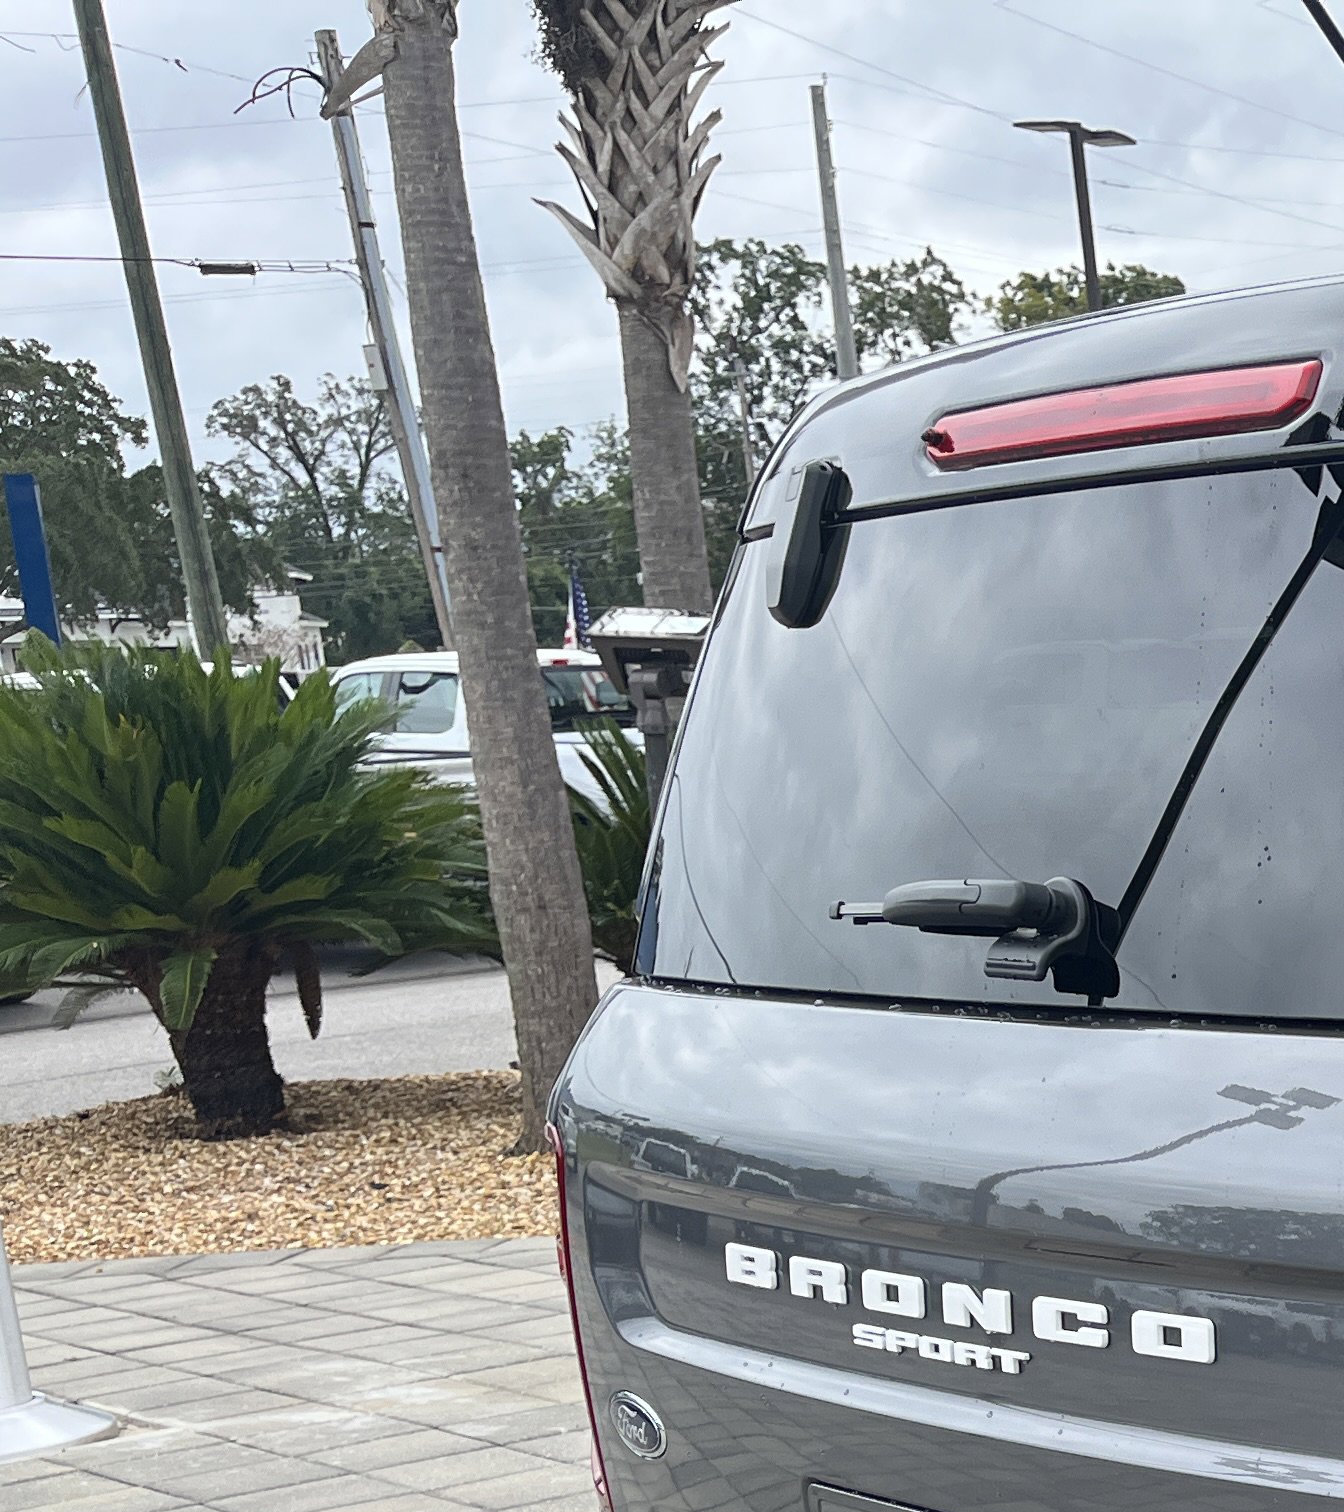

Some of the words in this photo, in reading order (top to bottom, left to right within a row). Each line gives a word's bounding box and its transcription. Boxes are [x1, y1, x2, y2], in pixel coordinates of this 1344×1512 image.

[725, 1242, 1217, 1364] BRONCO
[852, 1323, 1030, 1374] SPORT
[618, 1404, 648, 1445] Ford
